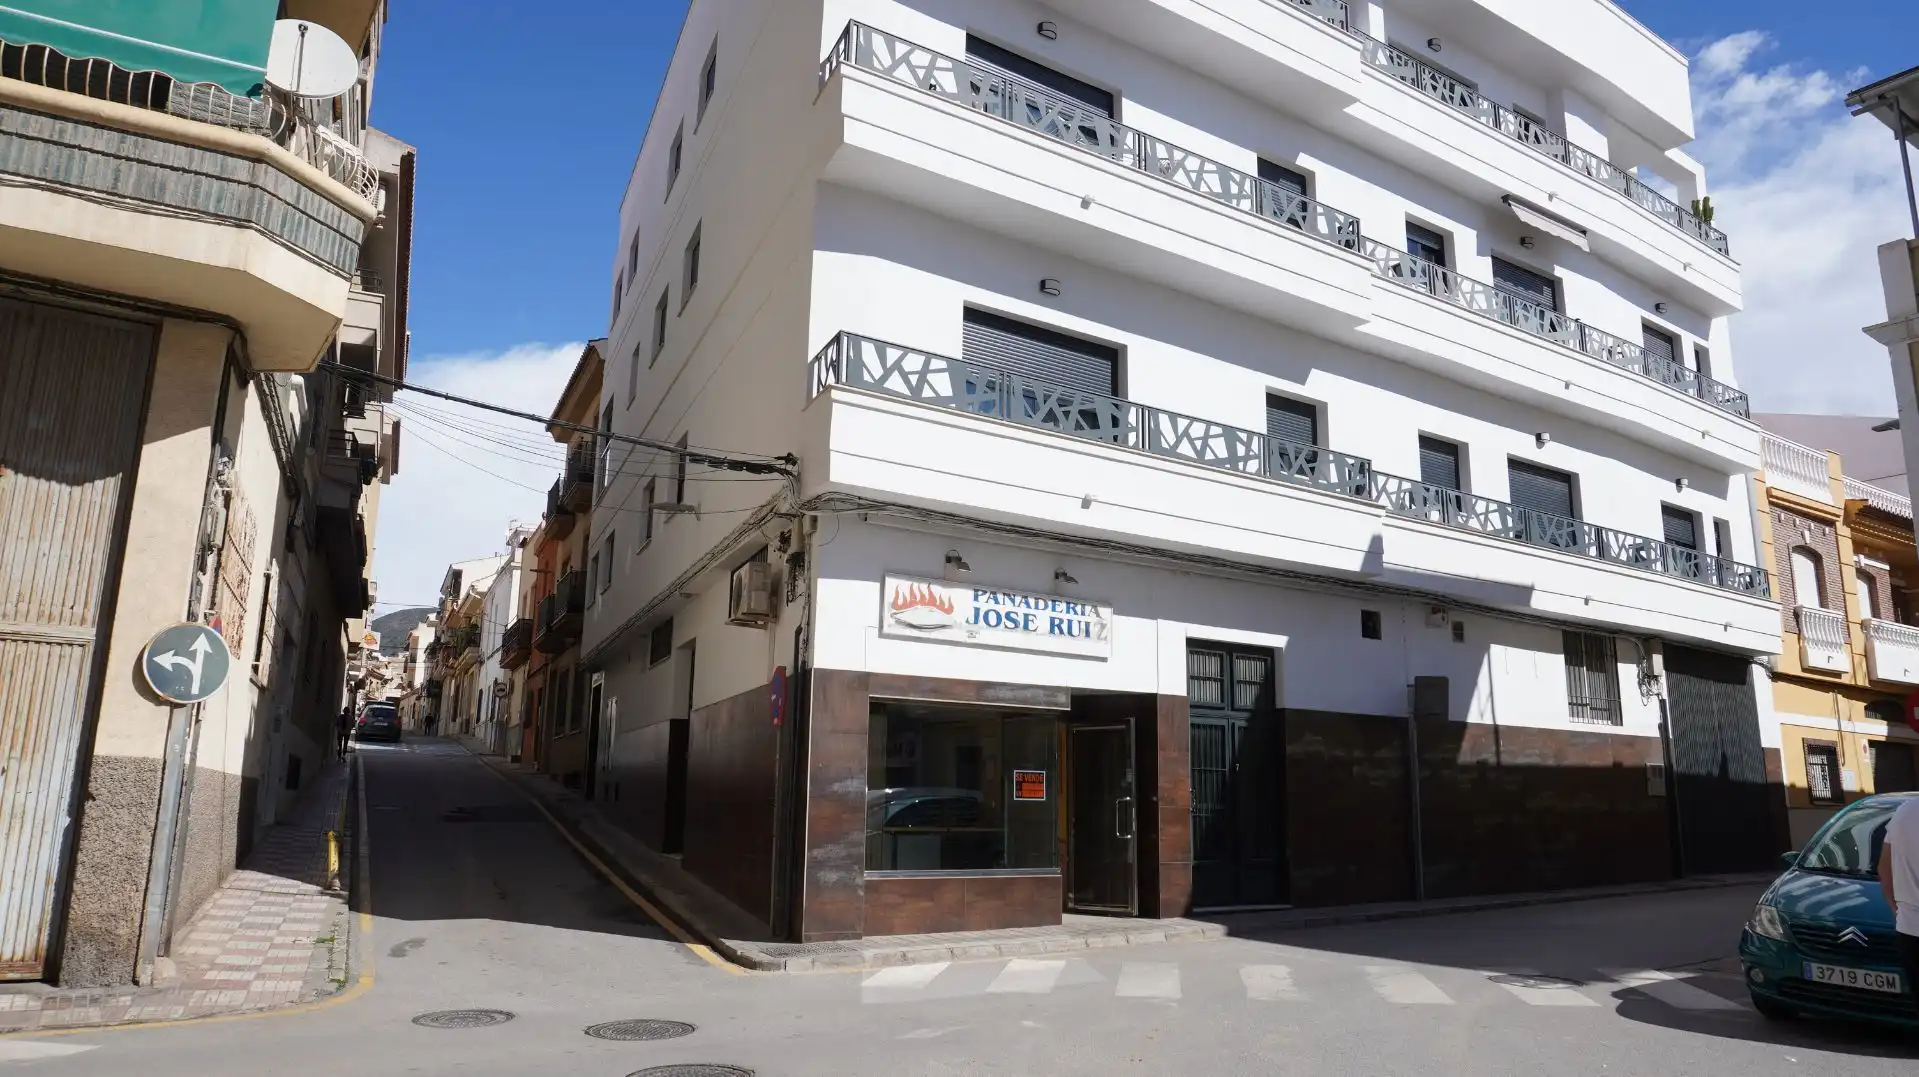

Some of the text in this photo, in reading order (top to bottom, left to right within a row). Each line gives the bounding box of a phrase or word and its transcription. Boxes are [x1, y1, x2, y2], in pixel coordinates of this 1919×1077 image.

[973, 588, 1103, 619] PANADERIA
[965, 606, 1108, 642] JOSE RUIZ
[1015, 772, 1044, 782] SE VENDE
[1816, 966, 1896, 990] 3719 CGM
